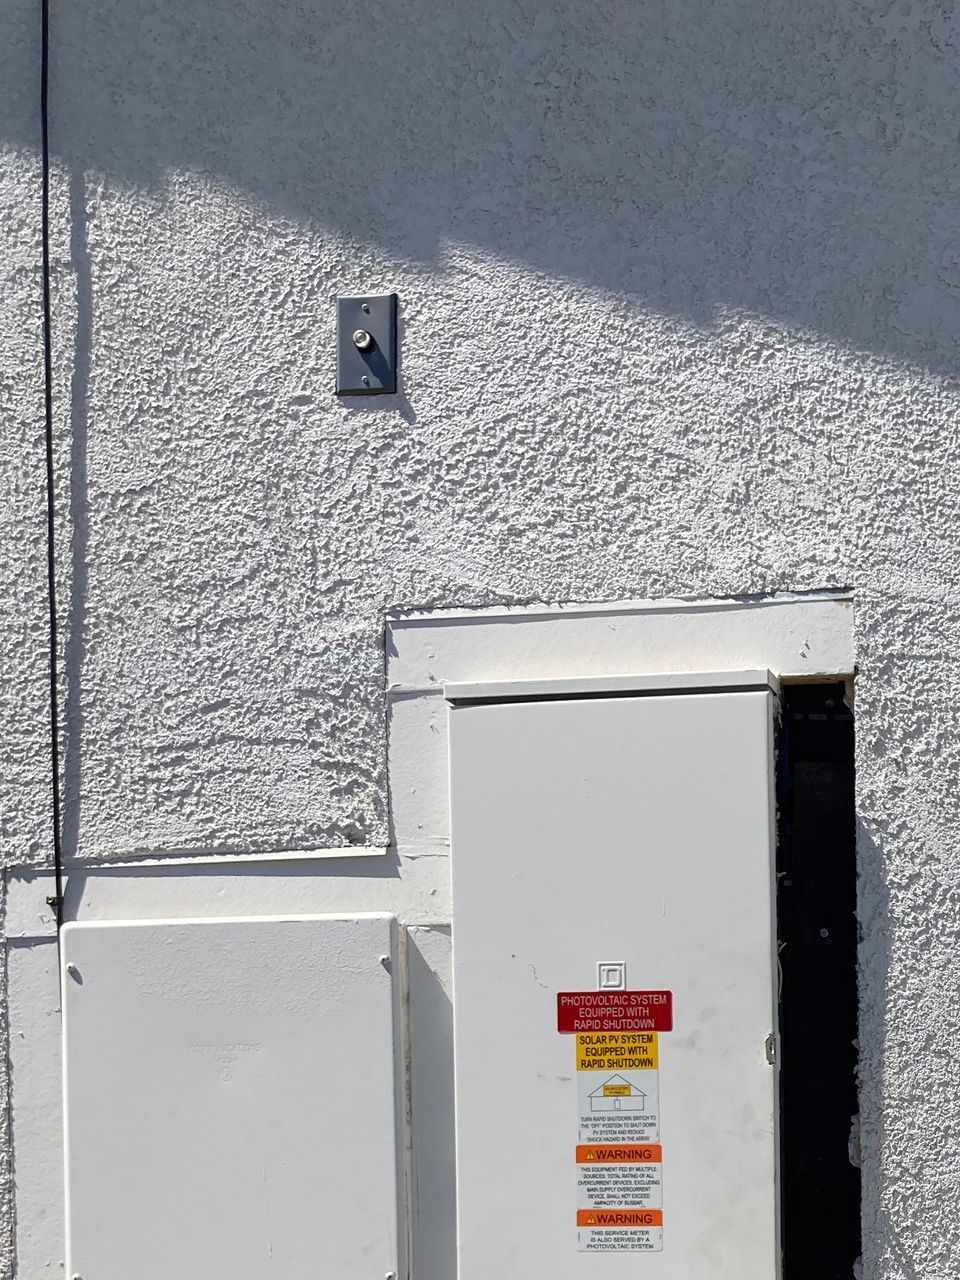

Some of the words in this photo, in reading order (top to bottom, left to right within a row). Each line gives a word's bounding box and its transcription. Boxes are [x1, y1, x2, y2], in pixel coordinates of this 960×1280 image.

[561, 996, 628, 1006] PHOTOVOLTAIC
[630, 995, 667, 1005] SYSTEM
[579, 1008, 624, 1018] EQUIPPED
[627, 1007, 649, 1017] WITH
[574, 1020, 601, 1030] RAPID
[603, 1019, 655, 1029] SHUTDOWN
[580, 1035, 607, 1045] SOLAR
[609, 1035, 619, 1044] PV
[621, 1034, 653, 1044] SYSTEM
[586, 1047, 626, 1056] EQUIPPED
[628, 1046, 648, 1056] WITH
[581, 1059, 605, 1069] RAPID
[607, 1058, 653, 1068] SHUTDOWN
[596, 1149, 652, 1159] WARNING
[597, 1214, 653, 1224] WARNING
